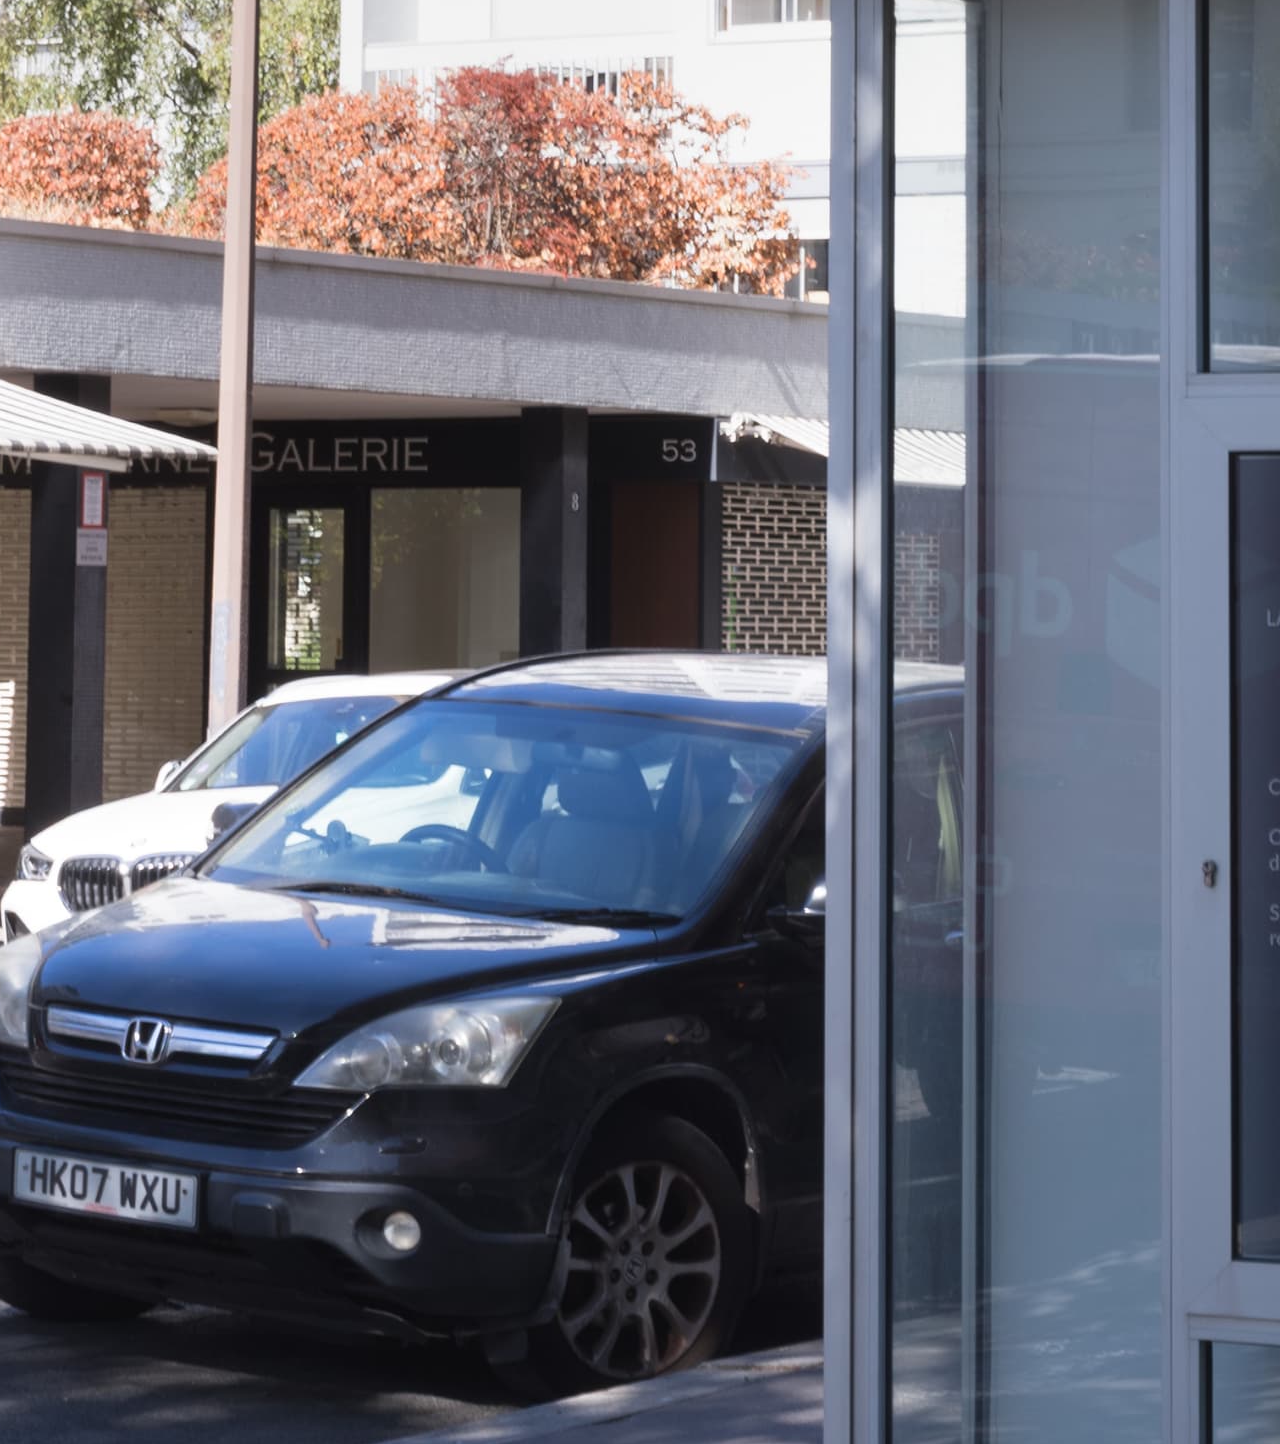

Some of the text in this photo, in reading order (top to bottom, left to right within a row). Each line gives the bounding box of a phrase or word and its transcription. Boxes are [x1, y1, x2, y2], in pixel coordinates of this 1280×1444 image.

[251, 432, 429, 472] GALERIE
[662, 439, 696, 462] 53
[30, 1156, 182, 1215] HK07 WXU
